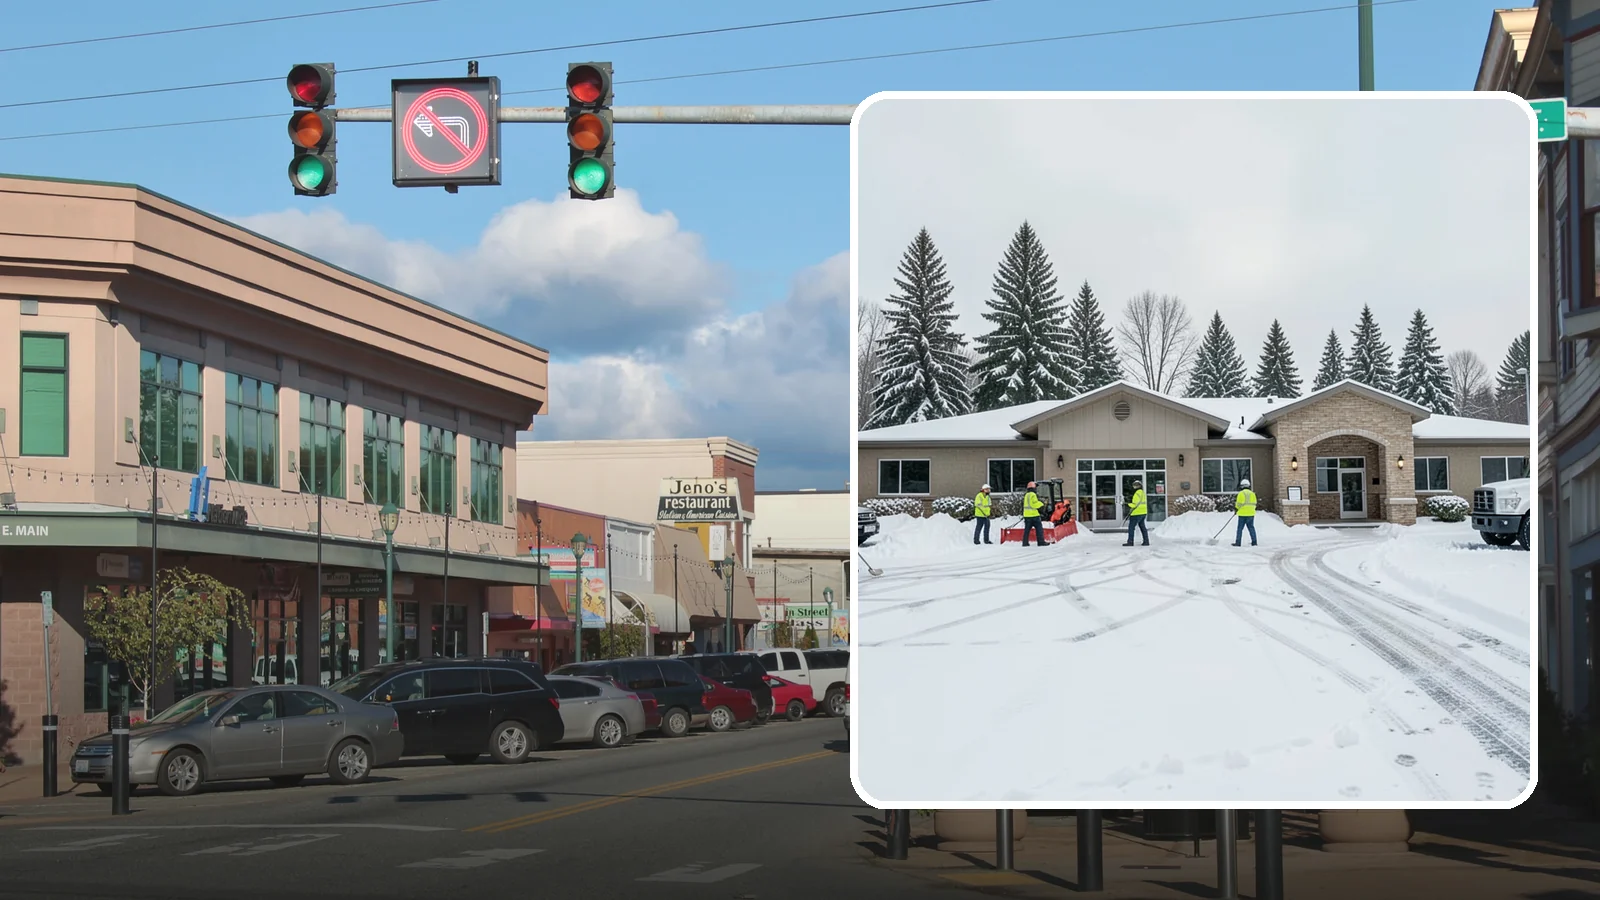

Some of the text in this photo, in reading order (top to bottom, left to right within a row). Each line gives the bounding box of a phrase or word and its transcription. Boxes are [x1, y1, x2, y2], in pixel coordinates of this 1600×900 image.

[670, 480, 727, 494] Jeno's
[665, 496, 731, 509] restaurant
[658, 509, 681, 520] Italian
[686, 509, 714, 519] American
[714, 509, 738, 519] Cuisine
[2, 525, 49, 536] E. MAIN
[797, 607, 829, 617] Street
